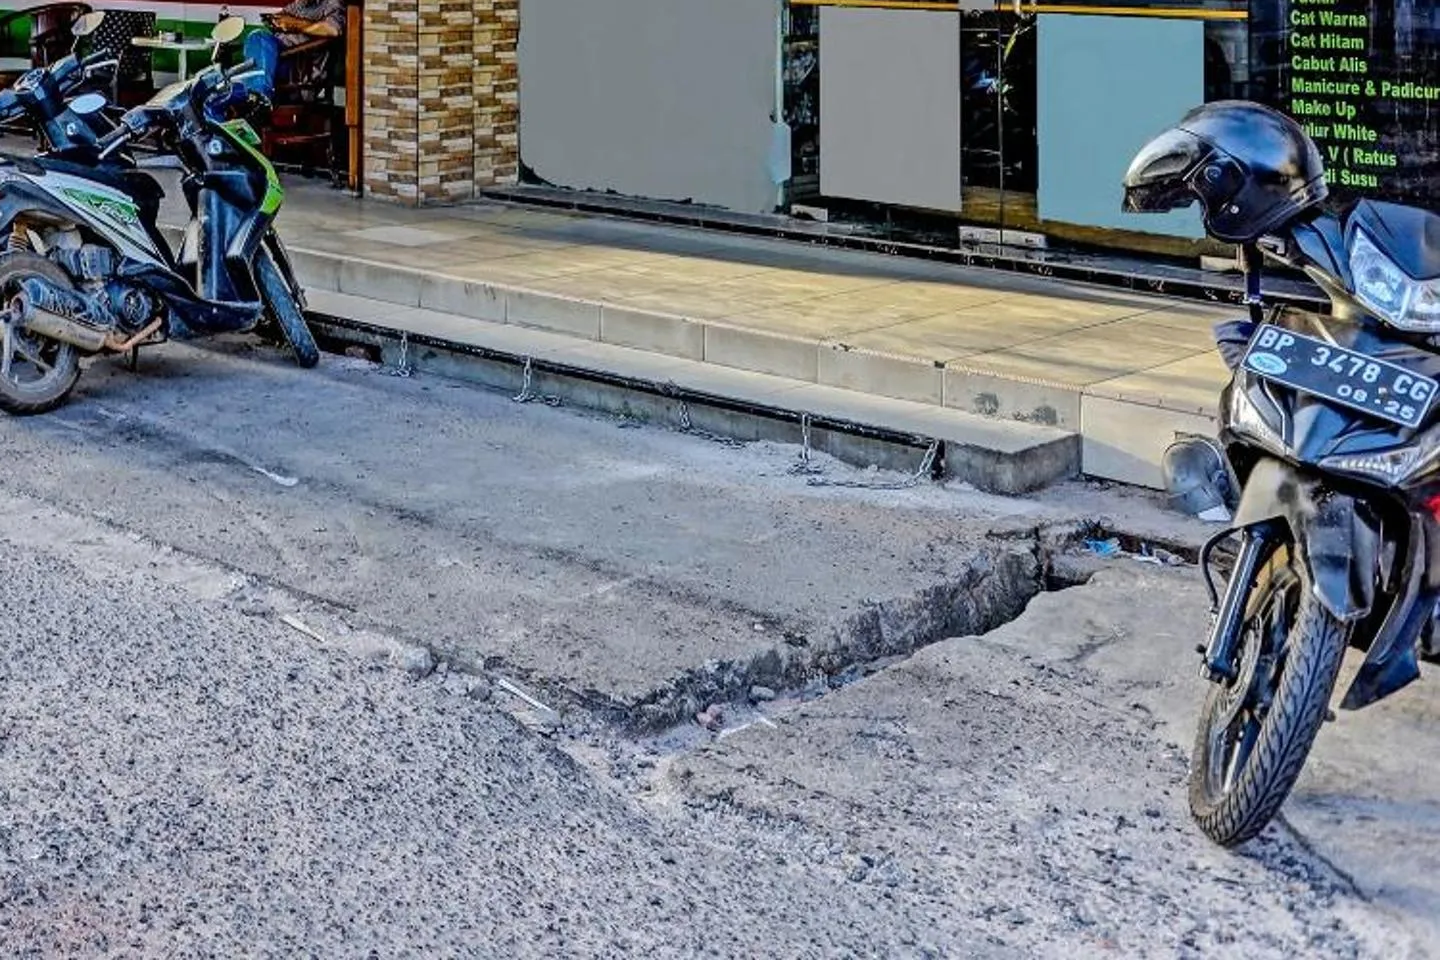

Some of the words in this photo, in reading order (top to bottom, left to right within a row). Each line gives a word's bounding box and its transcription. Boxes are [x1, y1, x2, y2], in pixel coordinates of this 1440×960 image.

[1290, 10, 1315, 26] Cat
[1319, 11, 1367, 27] Warna
[1291, 33, 1316, 48] Cat
[1320, 33, 1364, 50] Hitam
[1292, 55, 1335, 71] Cabut
[1339, 57, 1368, 73] Alis
[1292, 78, 1360, 96] Manicure
[1364, 80, 1377, 97] &
[1381, 81, 1440, 100] Padicur
[1292, 99, 1331, 116] Make
[1335, 102, 1356, 121] Up
[1333, 124, 1377, 141] White
[1353, 147, 1397, 167] Ratus
[1341, 170, 1378, 188] Susu
[1258, 329, 1295, 352] BP
[1311, 347, 1382, 384] 3478
[1393, 376, 1430, 401] CG
[1384, 400, 1416, 420] 25
